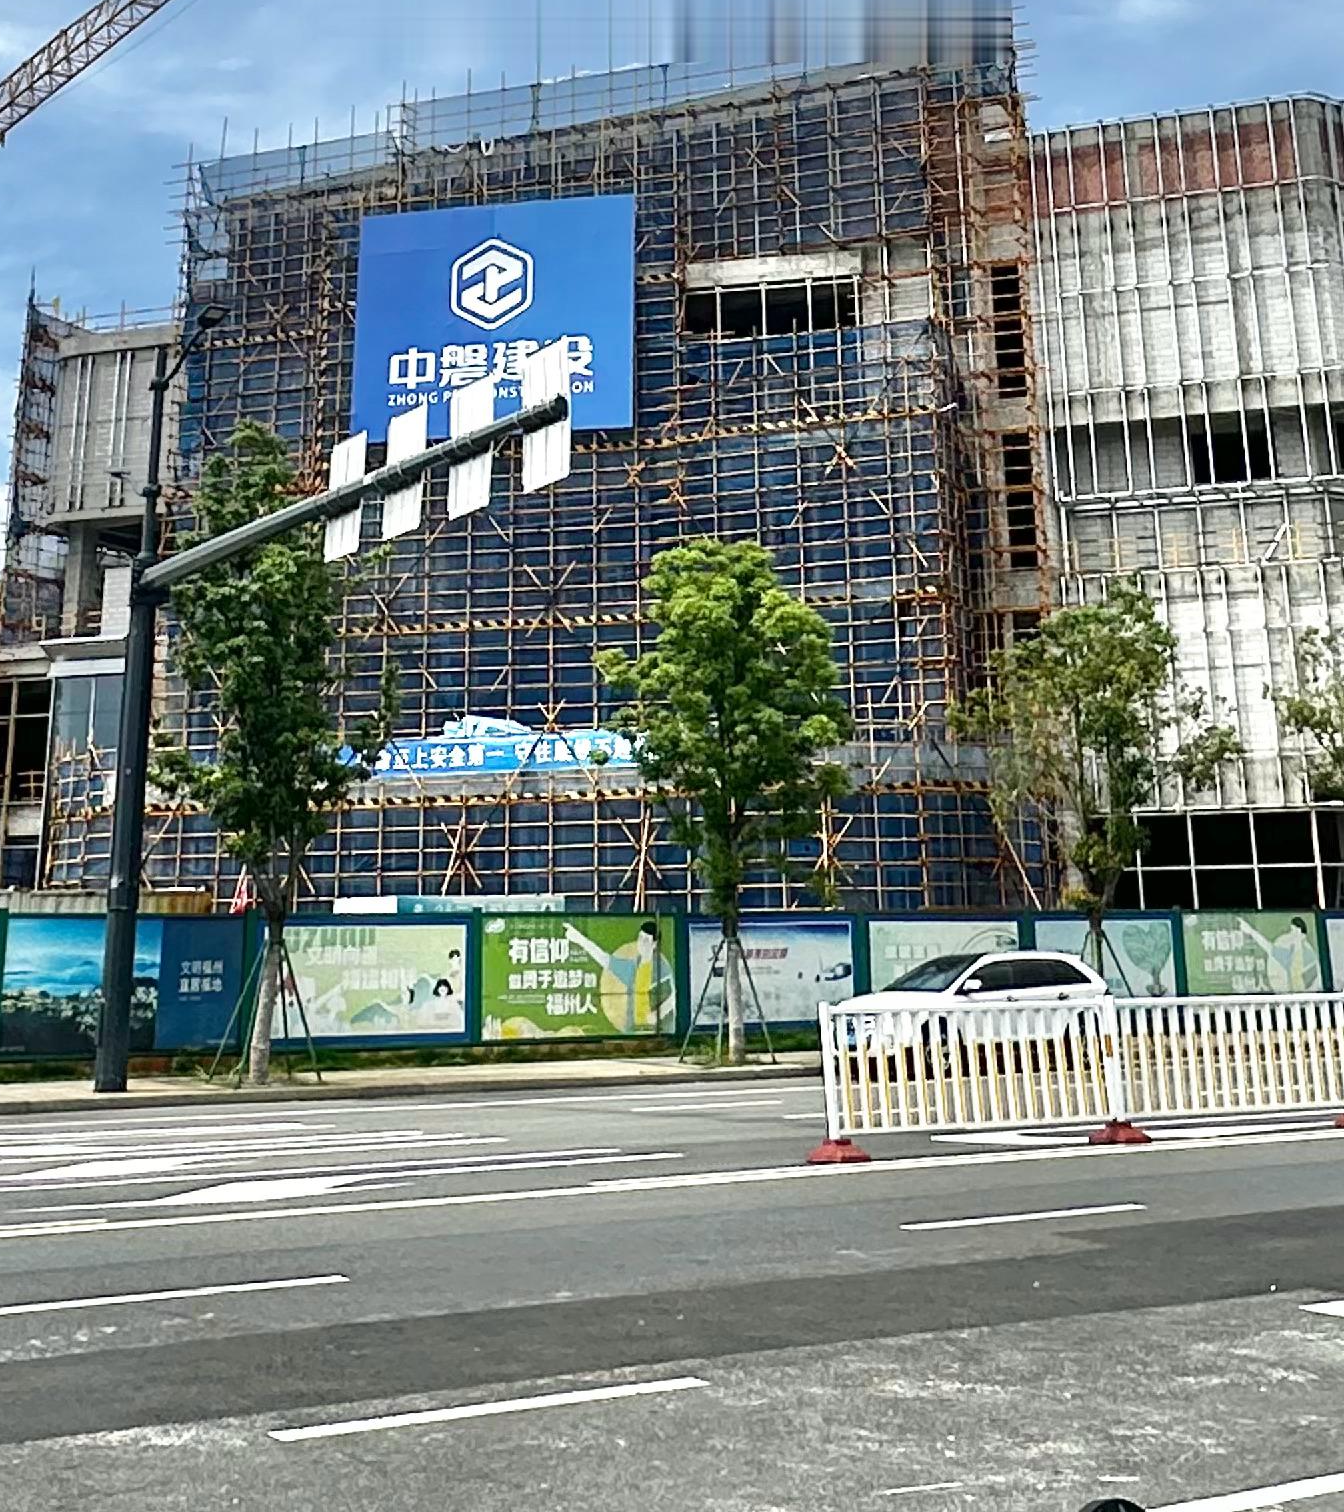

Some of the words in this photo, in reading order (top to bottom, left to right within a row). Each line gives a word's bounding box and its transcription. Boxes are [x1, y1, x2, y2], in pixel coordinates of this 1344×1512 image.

[388, 335, 594, 390] 中磐建设
[387, 391, 438, 407] ZHONG
[508, 937, 570, 965] 有信仰
[546, 993, 598, 1016] 福州人
